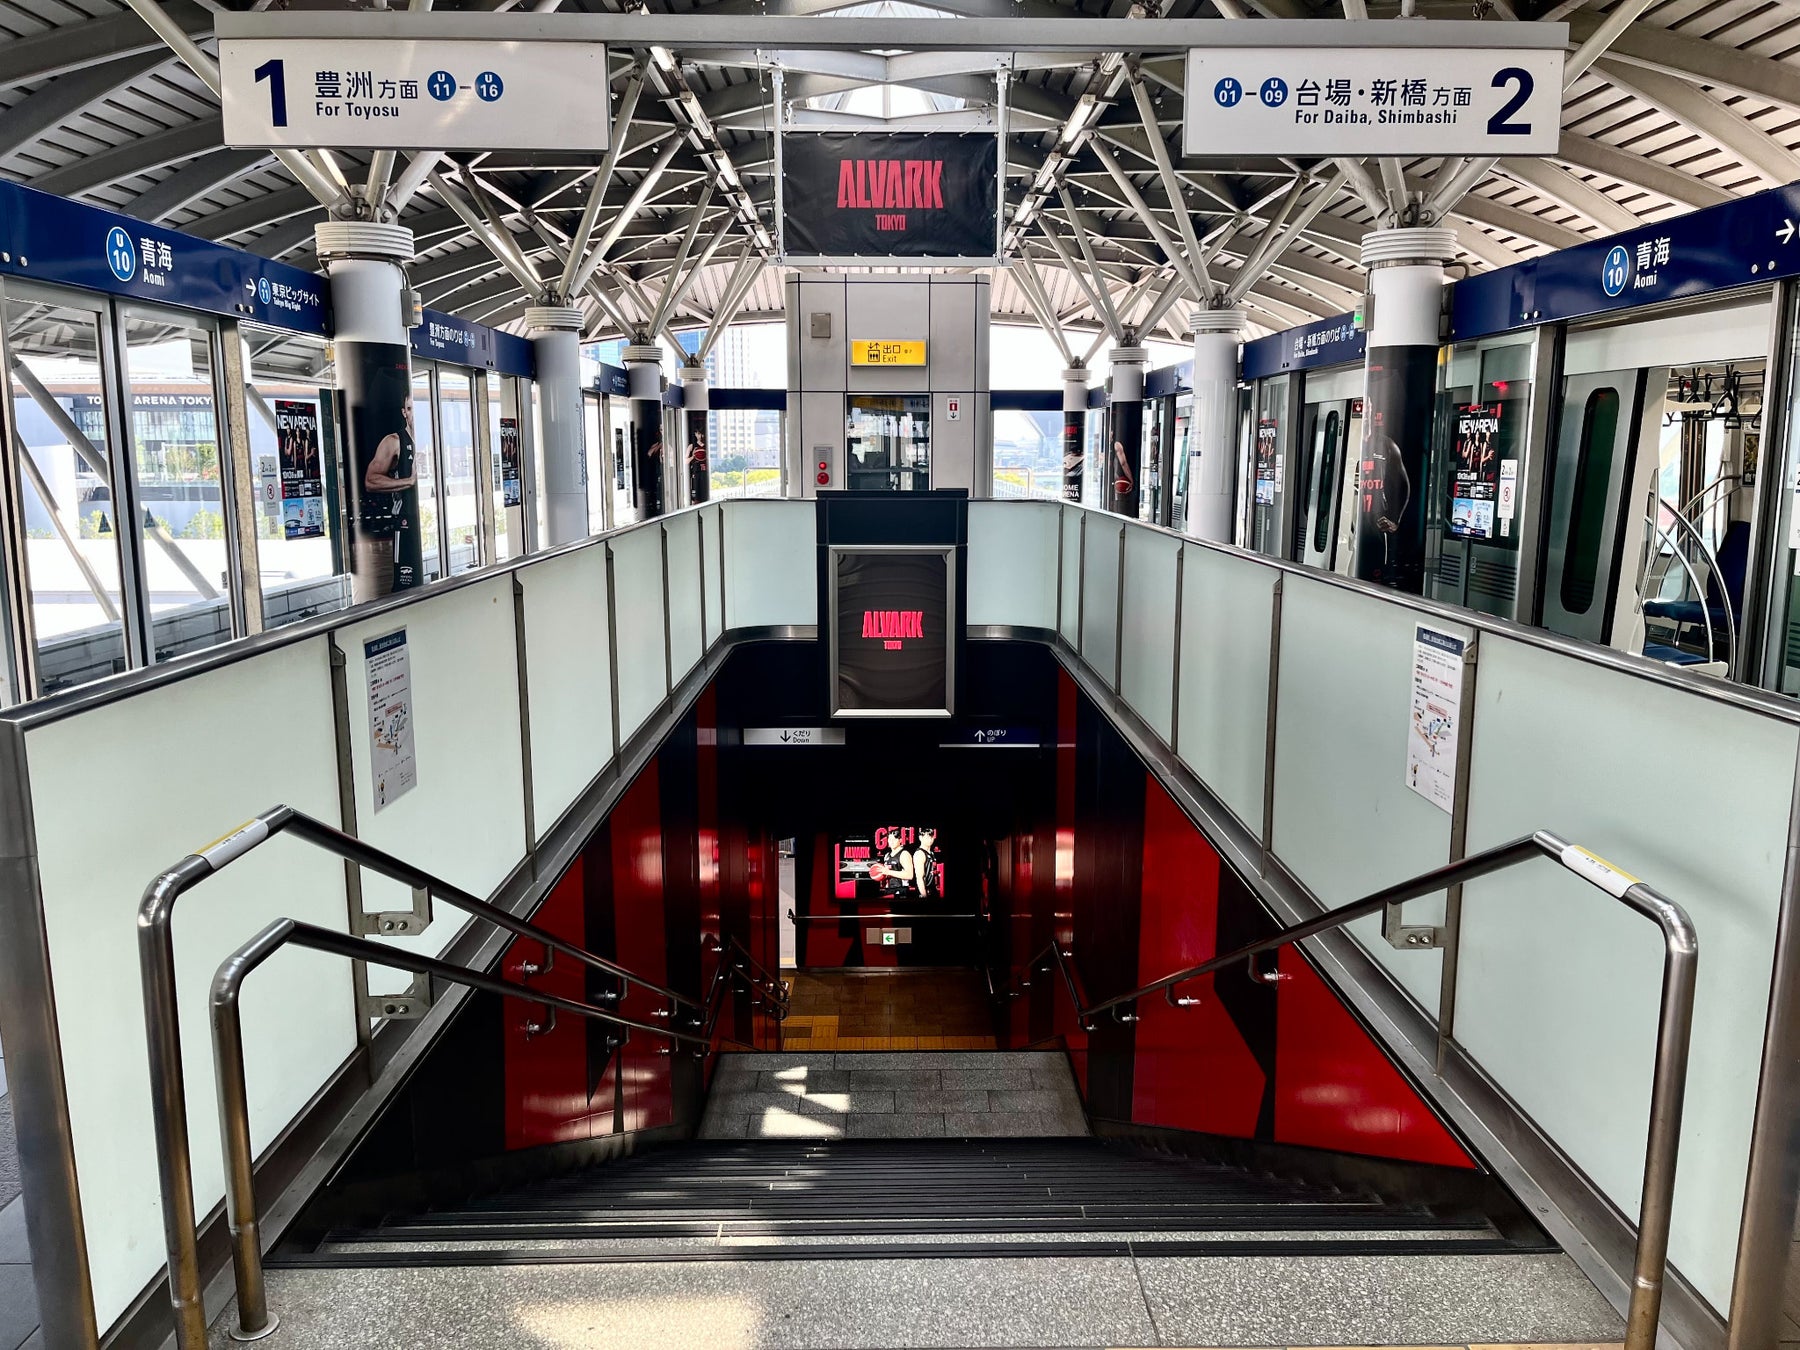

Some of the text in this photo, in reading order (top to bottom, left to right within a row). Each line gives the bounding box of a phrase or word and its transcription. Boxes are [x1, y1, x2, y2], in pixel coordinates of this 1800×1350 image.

[314, 71, 419, 100] 豊洲方面
[437, 73, 446, 83] U
[484, 74, 493, 83] U
[1224, 80, 1233, 89] U
[1270, 80, 1279, 89] U
[254, 59, 288, 127] 1
[433, 83, 450, 97] 11
[480, 84, 498, 97] 16
[1219, 89, 1236, 103] 01
[1265, 89, 1283, 103] 09
[1296, 78, 1472, 107] 台場・新橋方面
[1486, 67, 1535, 135] 2
[315, 102, 400, 120] For Toyosu
[1295, 109, 1457, 126] For Daiba, Shimbashi
[837, 159, 944, 209] ALVARK
[875, 214, 906, 231] TOKYO
[115, 233, 124, 248] U
[113, 249, 130, 272] 10
[140, 237, 173, 271] 青海
[1613, 251, 1621, 265] U
[1636, 237, 1671, 271] 青海
[143, 268, 165, 287] Aomi
[1608, 267, 1623, 288] 10
[1633, 270, 1658, 289] Aomi
[271, 282, 320, 307] 東京ビッグサイト
[882, 344, 901, 354] 出口
[882, 354, 897, 363] Exit
[134, 396, 177, 405] ARENA
[177, 396, 214, 405] TOKY
[862, 611, 924, 638] ALVARK
[792, 729, 811, 738] くだり
